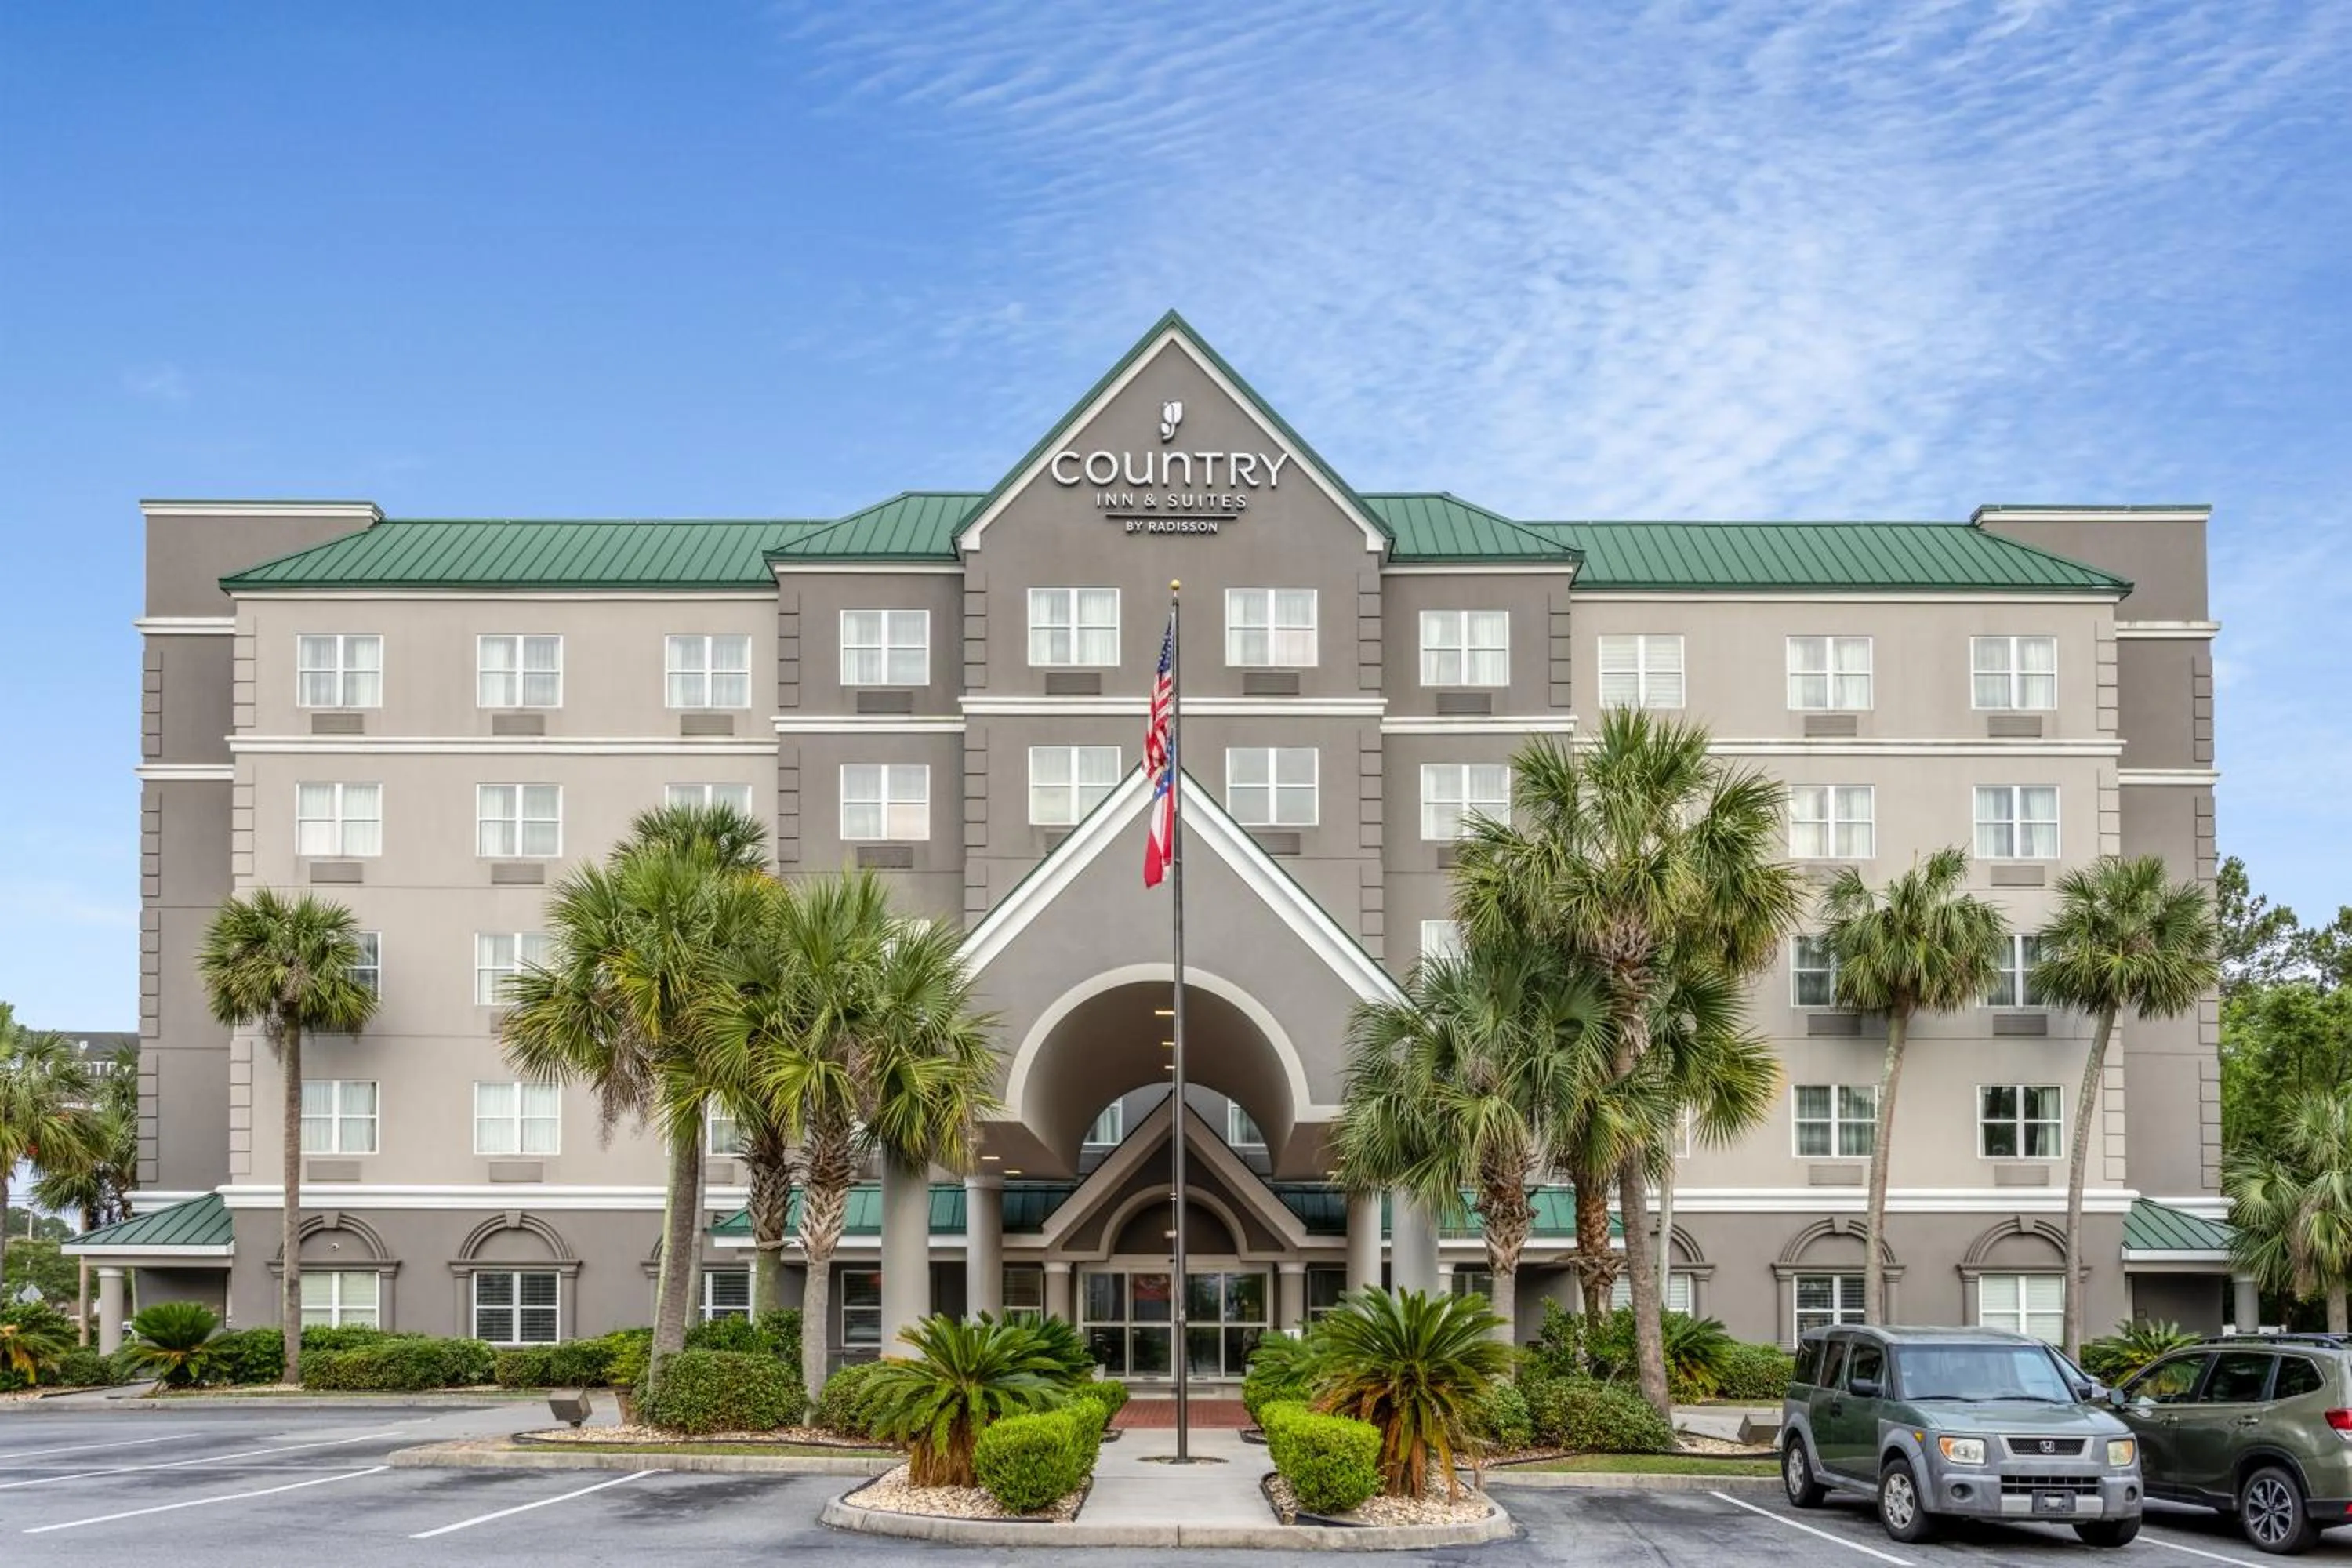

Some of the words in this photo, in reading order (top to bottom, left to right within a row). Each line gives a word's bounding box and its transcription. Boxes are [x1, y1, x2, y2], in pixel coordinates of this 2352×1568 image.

[1096, 493, 1134, 509] INN
[1143, 493, 1157, 509] &
[1167, 493, 1247, 510] SUITES
[1125, 521, 1143, 533] BY
[1148, 521, 1218, 535] RADISSON
